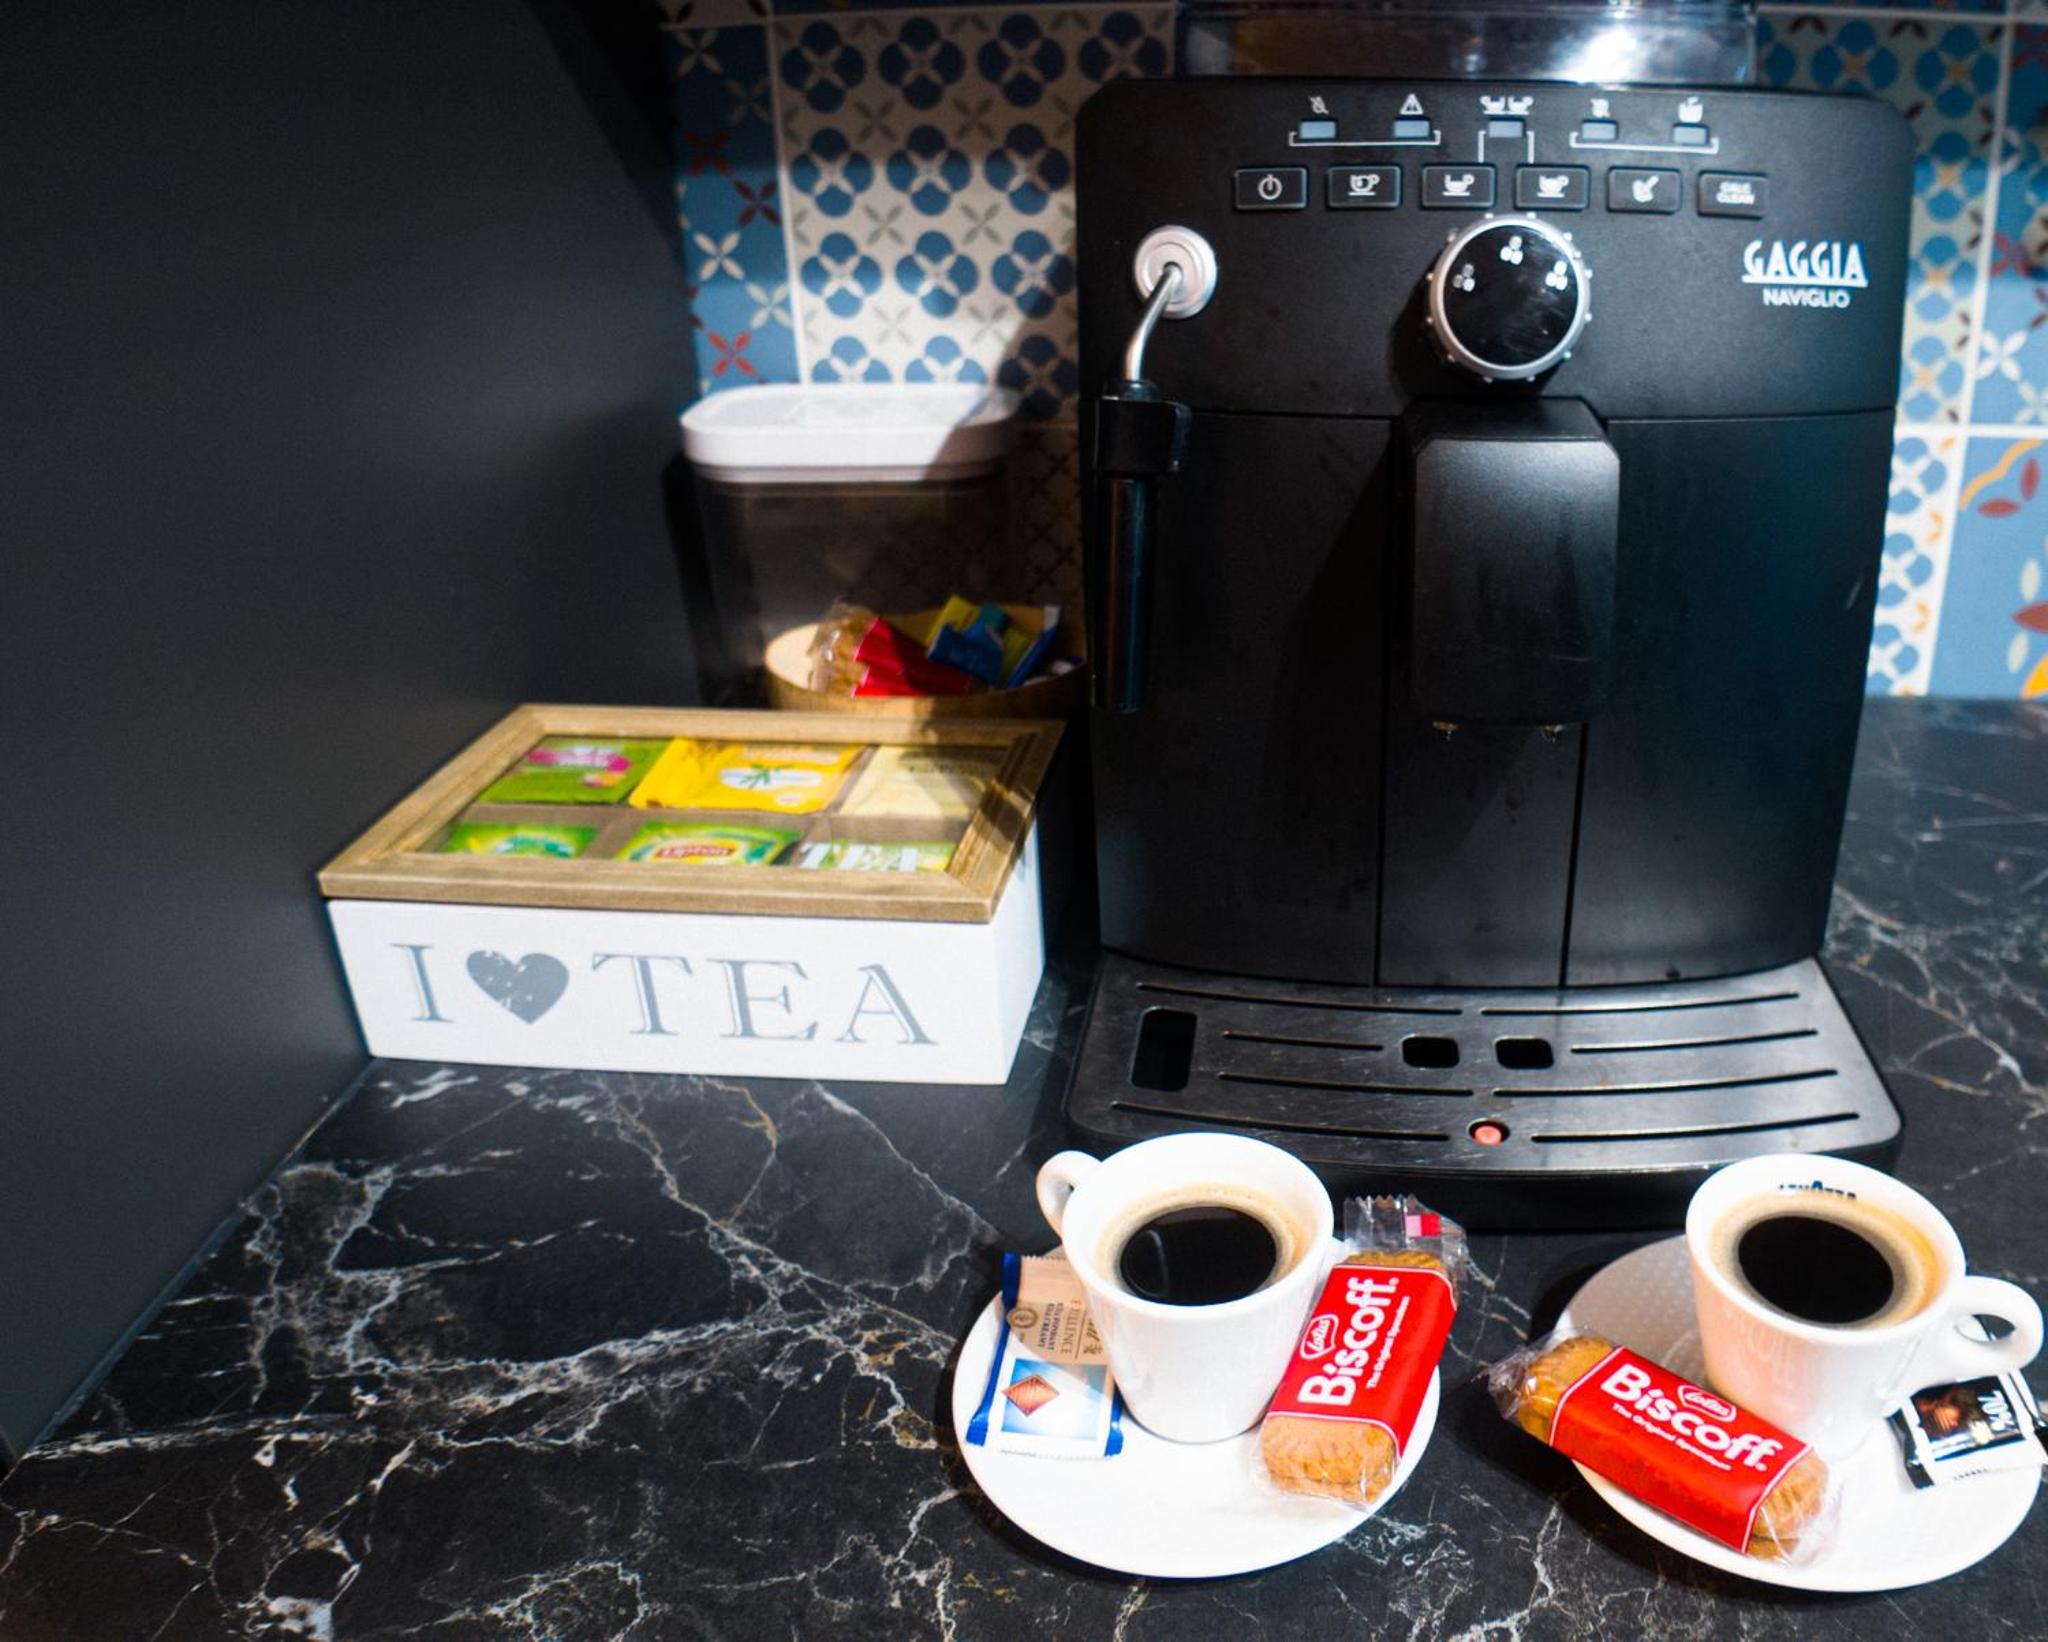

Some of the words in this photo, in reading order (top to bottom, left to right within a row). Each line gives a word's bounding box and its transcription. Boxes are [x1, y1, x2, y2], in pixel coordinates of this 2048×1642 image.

[1742, 240, 1869, 287] GAGGIA
[1763, 289, 1851, 308] NAVIGLIO
[391, 943, 453, 1024] I
[591, 952, 939, 1046] TEA
[1306, 1319, 1331, 1352] Lotus
[1977, 1389, 2015, 1432] 70%
